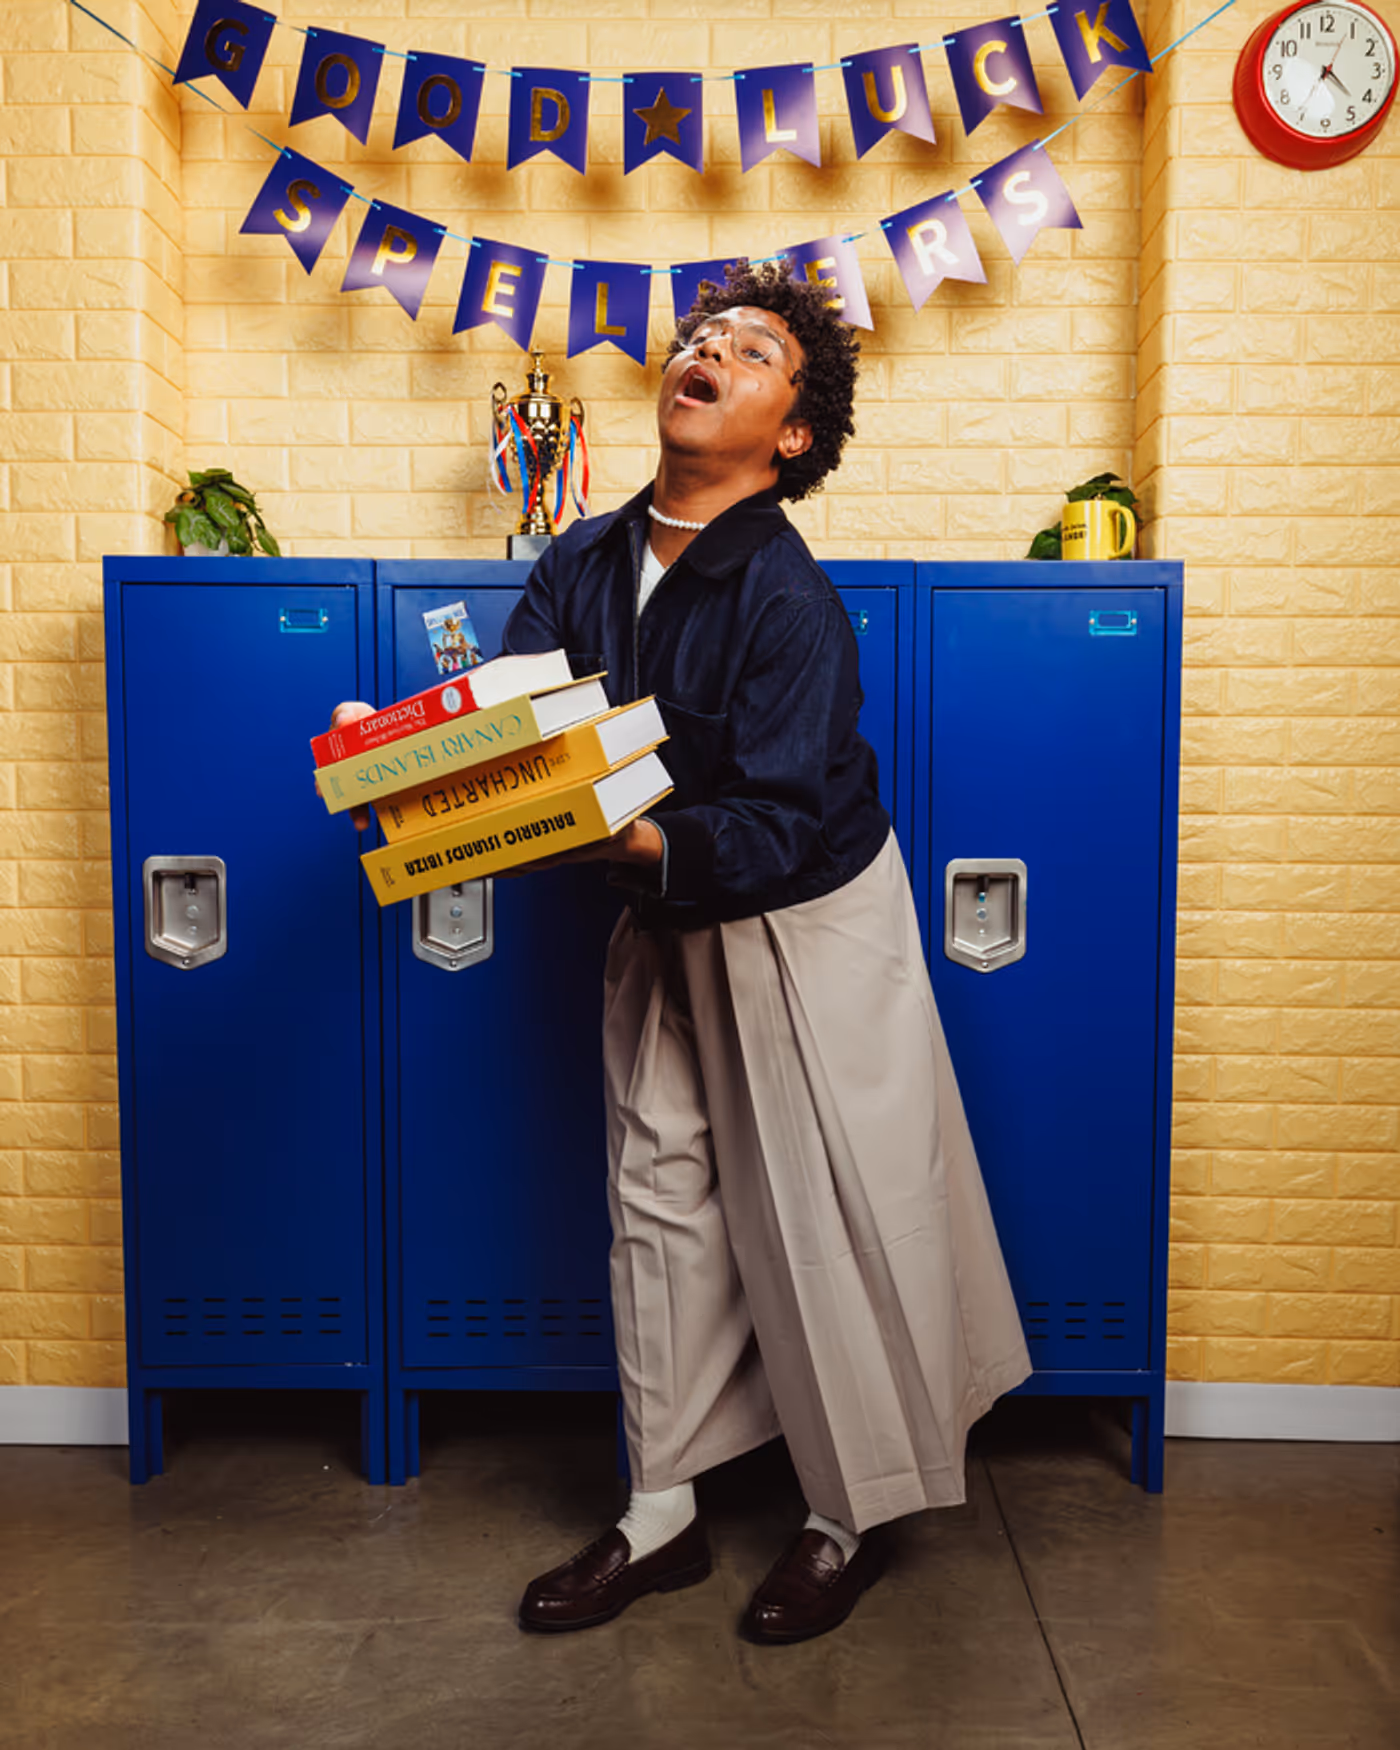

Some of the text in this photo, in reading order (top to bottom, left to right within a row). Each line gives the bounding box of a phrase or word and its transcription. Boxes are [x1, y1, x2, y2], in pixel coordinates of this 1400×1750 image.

[1300, 22, 1311, 39] 11
[1320, 15, 1335, 33] 12
[1350, 22, 1355, 39] 1
[1281, 40, 1298, 57] 10
[1365, 38, 1376, 57] 2
[204, 1, 1130, 143] GOOD LUCK
[1272, 64, 1283, 80] 9
[1371, 62, 1381, 80] 3
[1280, 89, 1290, 105] 8
[1362, 88, 1373, 103] 4
[1346, 106, 1356, 121] 5
[272, 170, 1050, 337] SPELERS
[360, 700, 425, 736] Dictionary
[441, 714, 522, 759] CANARY
[355, 745, 437, 789] ISLANDS
[422, 755, 552, 817] UNCHARTED
[404, 811, 576, 876] BALEARIC ISLANDS IBIZA
